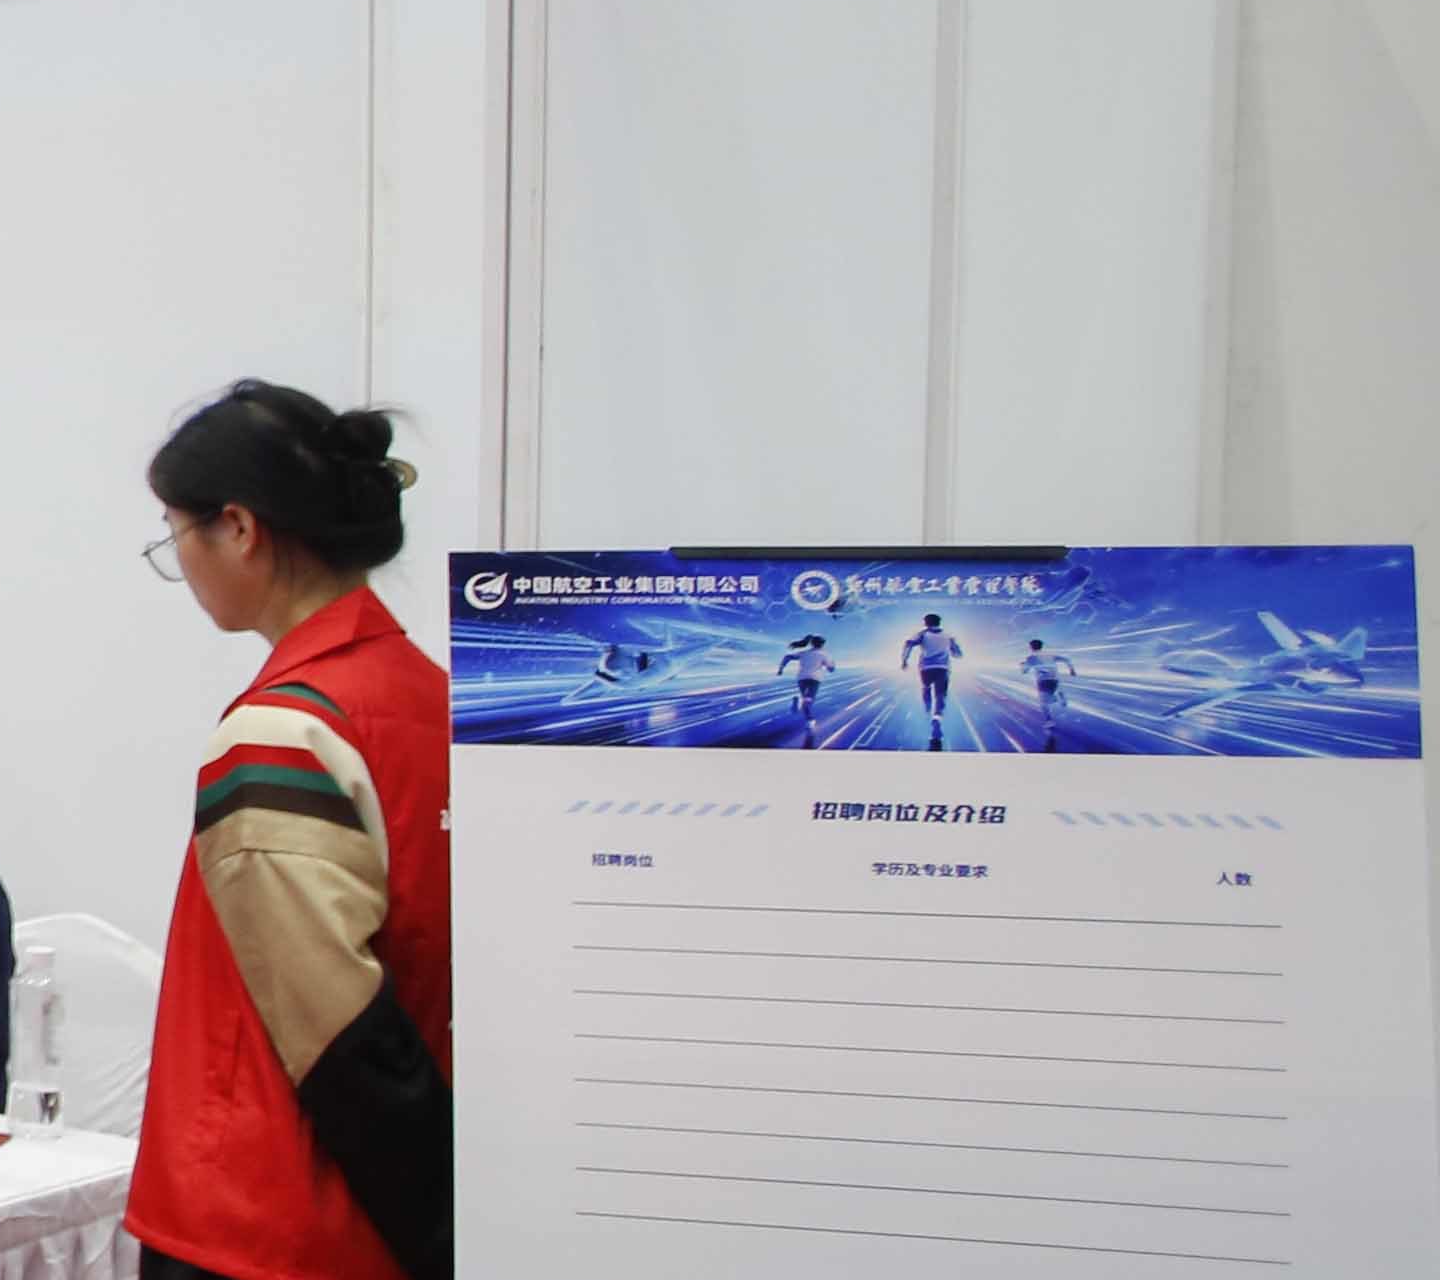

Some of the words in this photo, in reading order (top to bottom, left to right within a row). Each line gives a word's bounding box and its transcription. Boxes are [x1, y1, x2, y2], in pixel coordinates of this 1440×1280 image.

[512, 575, 760, 594] 中国航空工业集团有限公司
[812, 801, 1007, 825] 招聘岗位及介绍
[591, 852, 655, 868] 招聘岗位
[872, 861, 989, 879] 学历及专业要求
[1216, 870, 1253, 887] 人数
